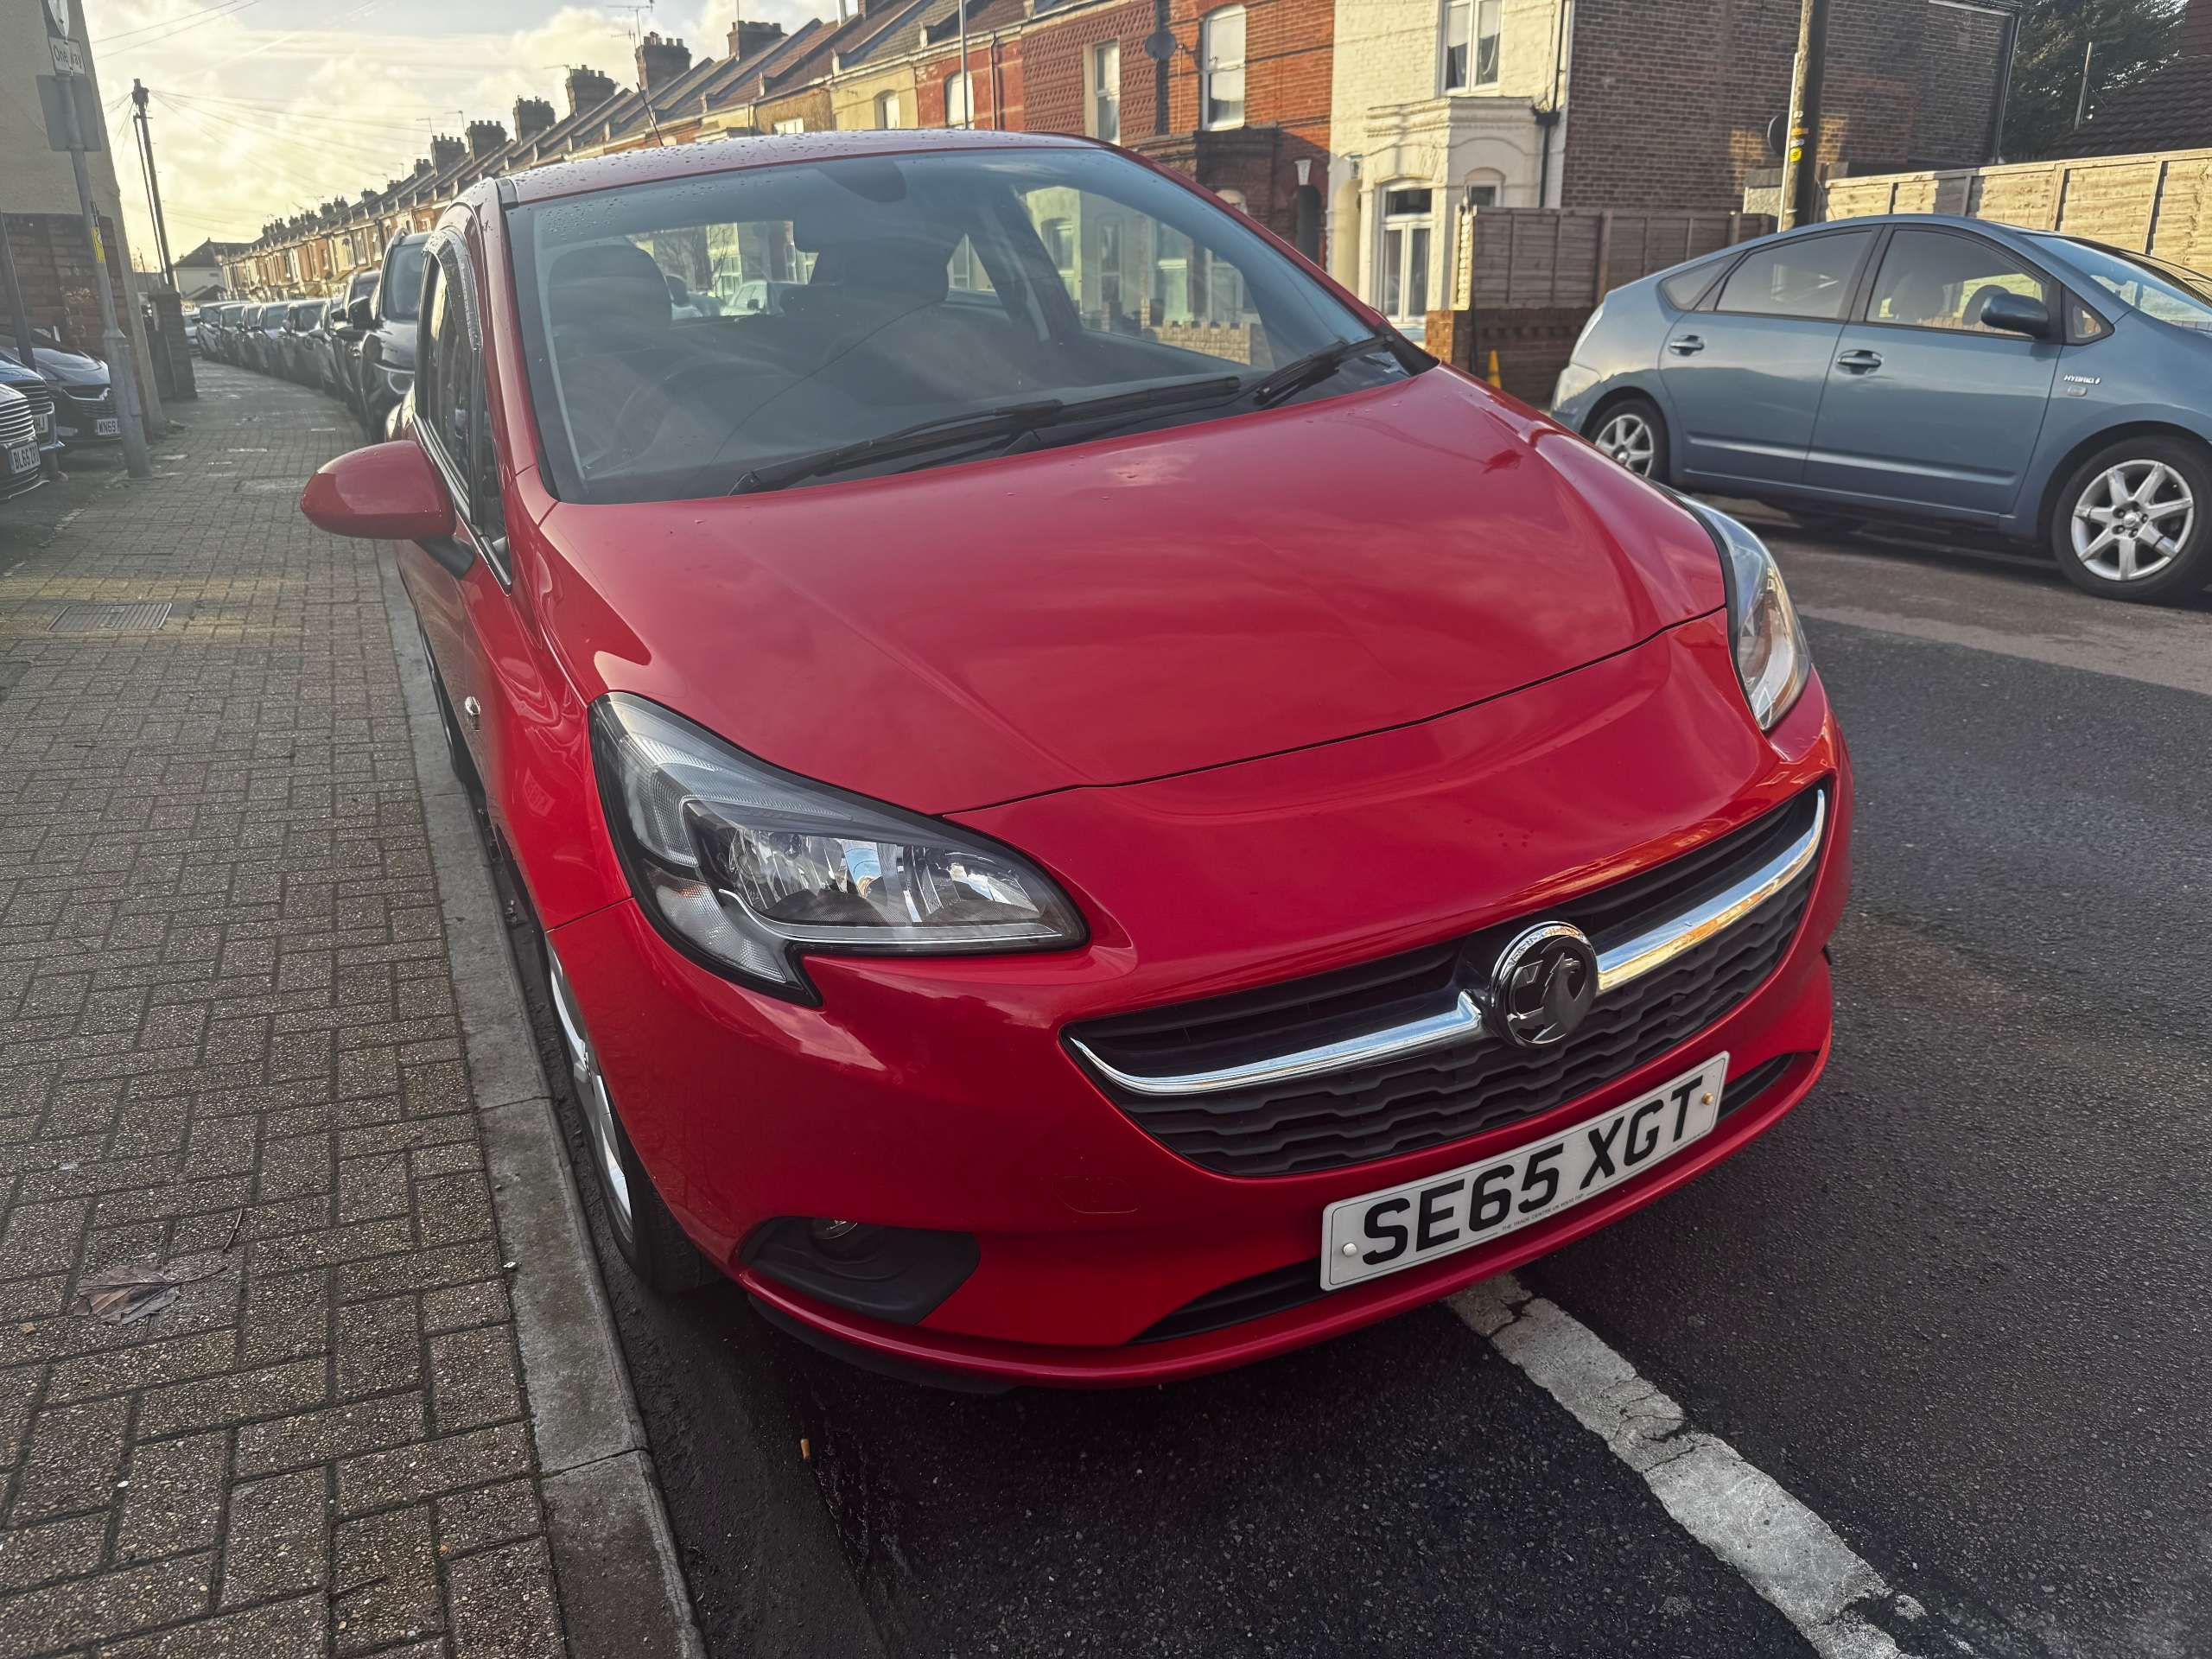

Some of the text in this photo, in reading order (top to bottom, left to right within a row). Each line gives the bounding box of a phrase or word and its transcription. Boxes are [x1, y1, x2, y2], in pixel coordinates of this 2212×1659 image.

[54, 45, 68, 62] One
[1363, 1075, 1704, 1266] SE65 XGT
